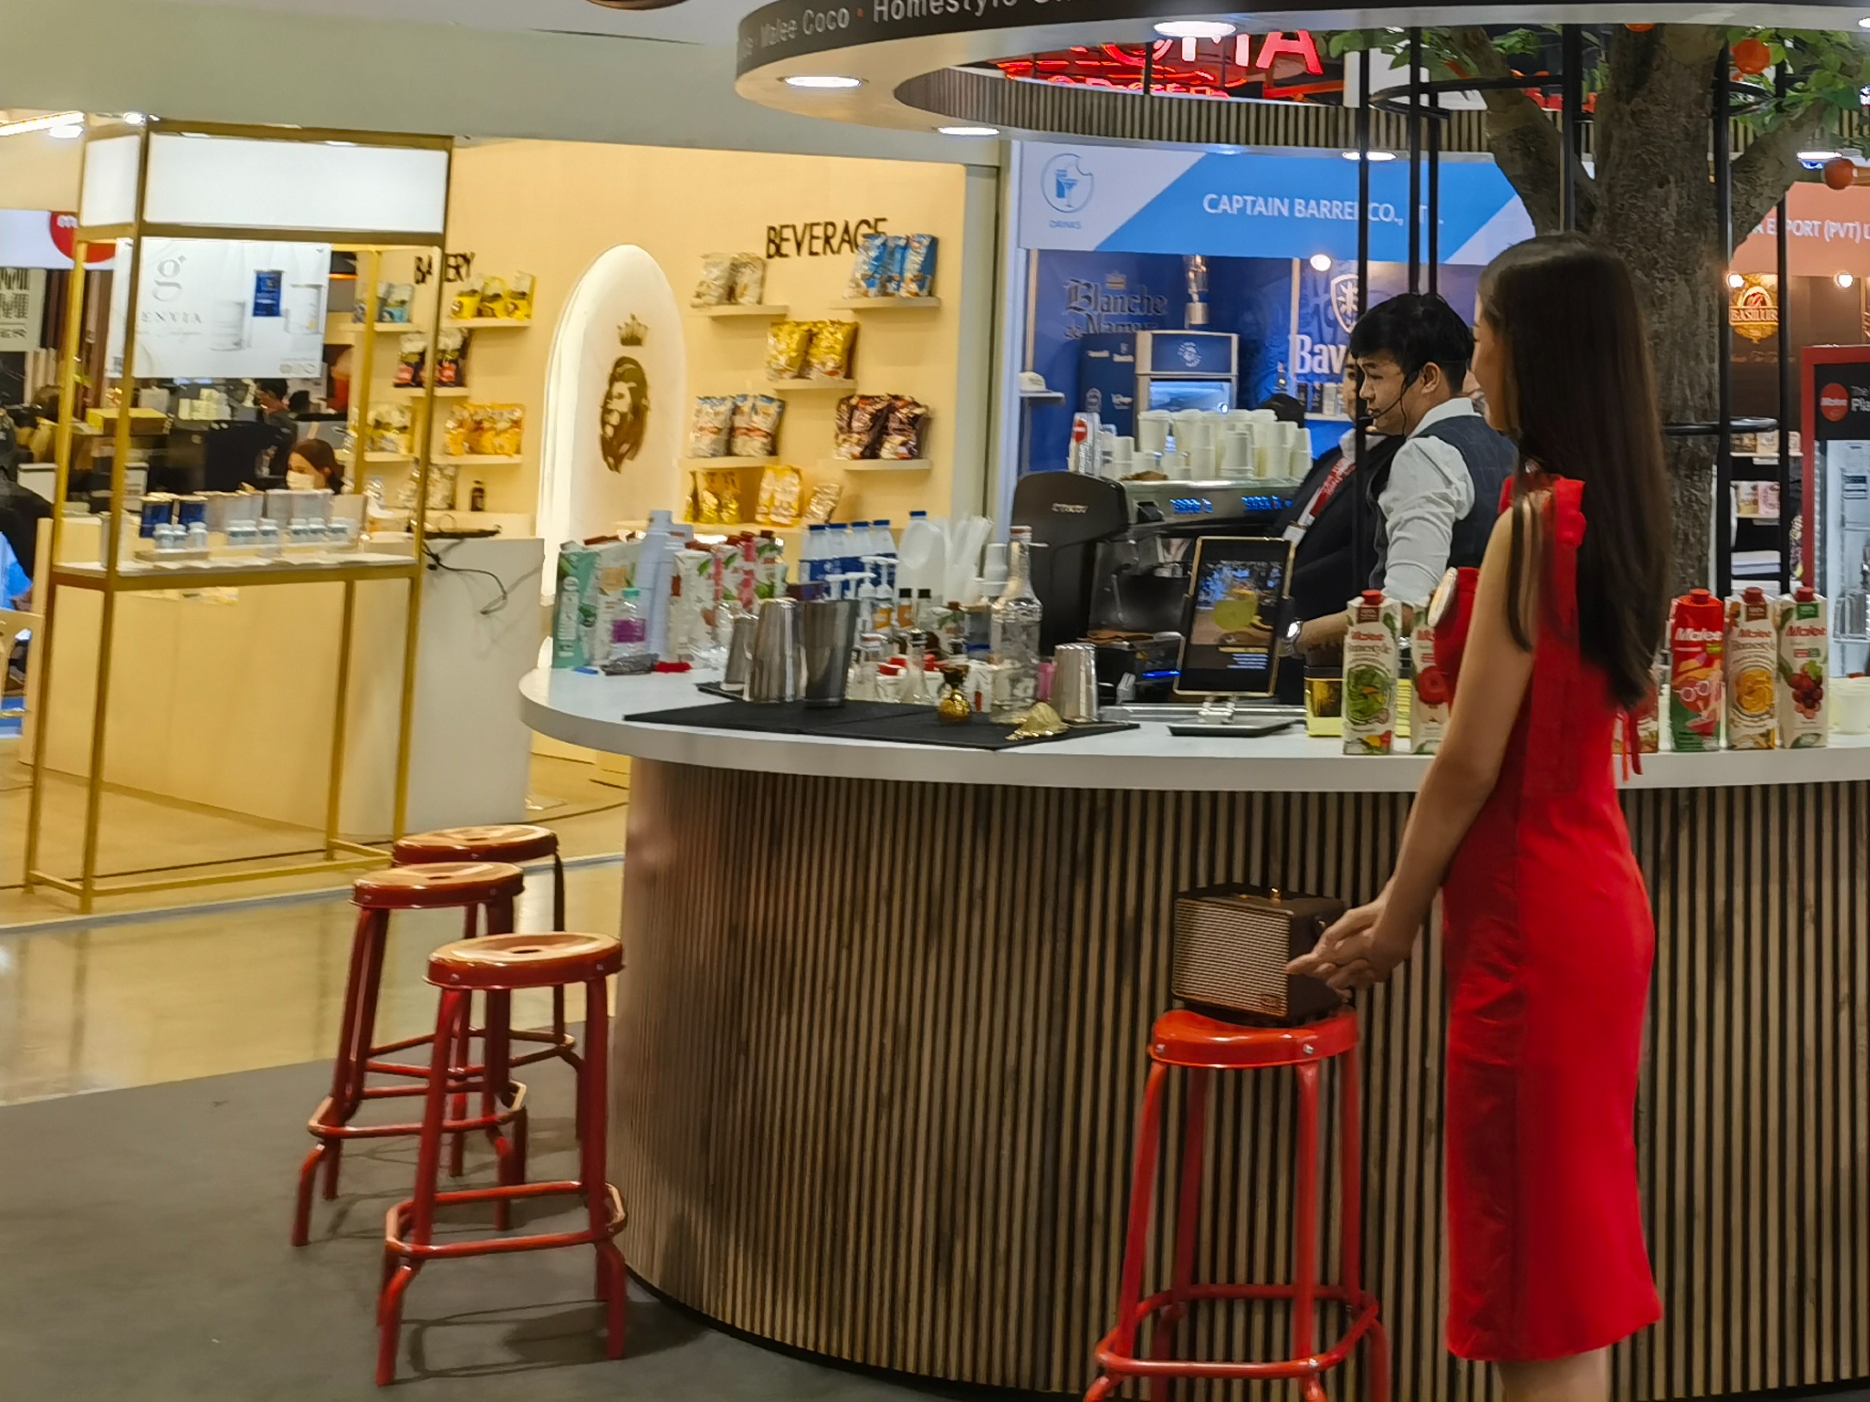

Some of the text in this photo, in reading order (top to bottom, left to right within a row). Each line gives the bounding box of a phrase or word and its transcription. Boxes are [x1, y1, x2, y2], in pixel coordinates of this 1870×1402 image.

[803, 9, 850, 35] Coco
[1203, 194, 1289, 218] CAPTAIN
[1368, 203, 1404, 226] CO.,
[1766, 217, 1822, 236] EPORT
[1824, 219, 1861, 243] (PVT)
[1295, 335, 1347, 374] Bav
